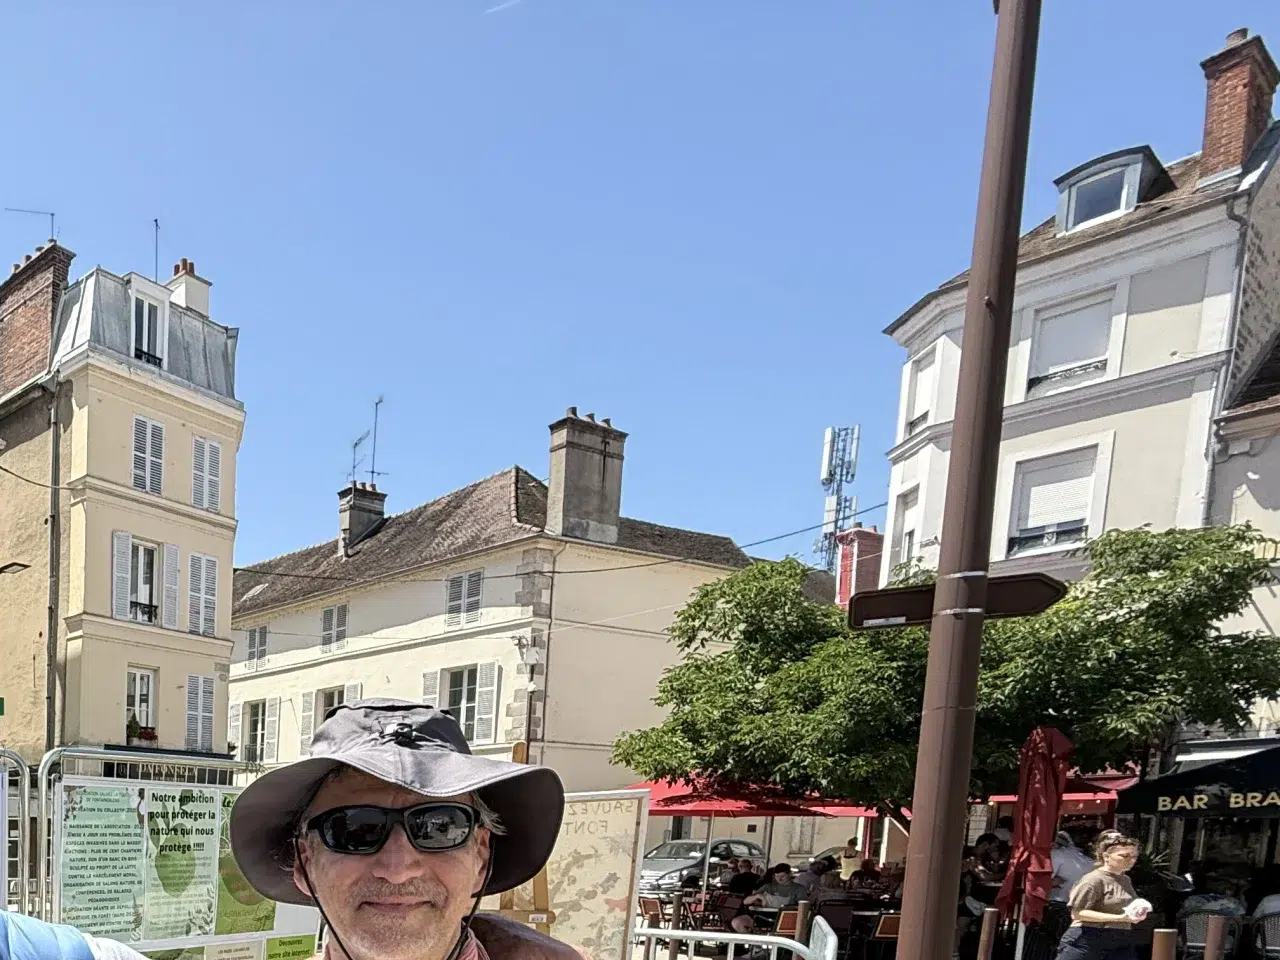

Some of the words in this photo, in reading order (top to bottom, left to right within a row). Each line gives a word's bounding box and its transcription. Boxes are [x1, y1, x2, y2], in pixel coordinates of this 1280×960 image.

[152, 792, 176, 803] Notre
[178, 793, 214, 804] ambition
[1158, 794, 1209, 812] BAR
[148, 811, 170, 822] pour
[172, 809, 206, 822] protéger
[208, 810, 216, 819] la
[150, 827, 178, 836] nature
[180, 826, 193, 838] qui
[195, 828, 214, 836] nous
[160, 842, 192, 855] protège
[282, 950, 292, 959] site
